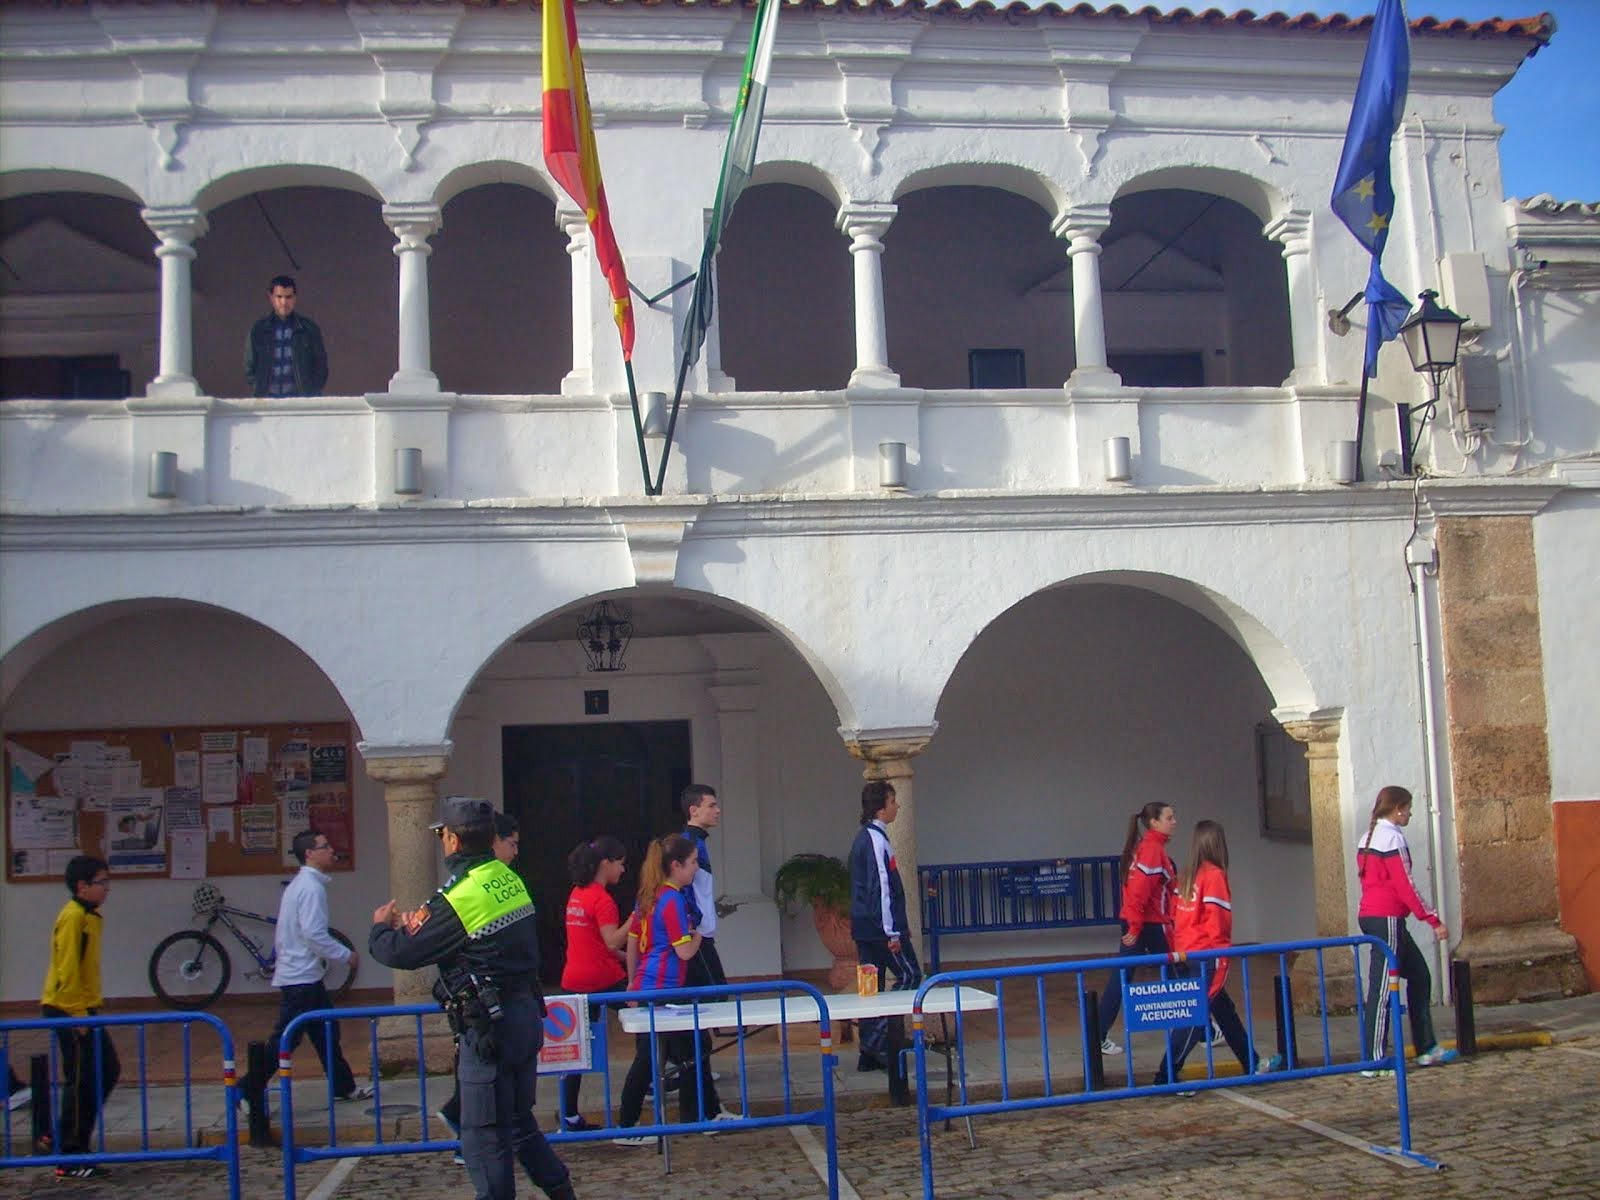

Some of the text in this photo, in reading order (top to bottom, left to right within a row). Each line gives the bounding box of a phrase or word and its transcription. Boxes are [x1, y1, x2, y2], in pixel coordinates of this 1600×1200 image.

[494, 883, 526, 904] LOCAL
[1129, 981, 1200, 996] POLICIA LOCAL
[1134, 999, 1198, 1012] AYUNTAMIENTO DE
[1141, 1008, 1193, 1022] ACEUCHAL
